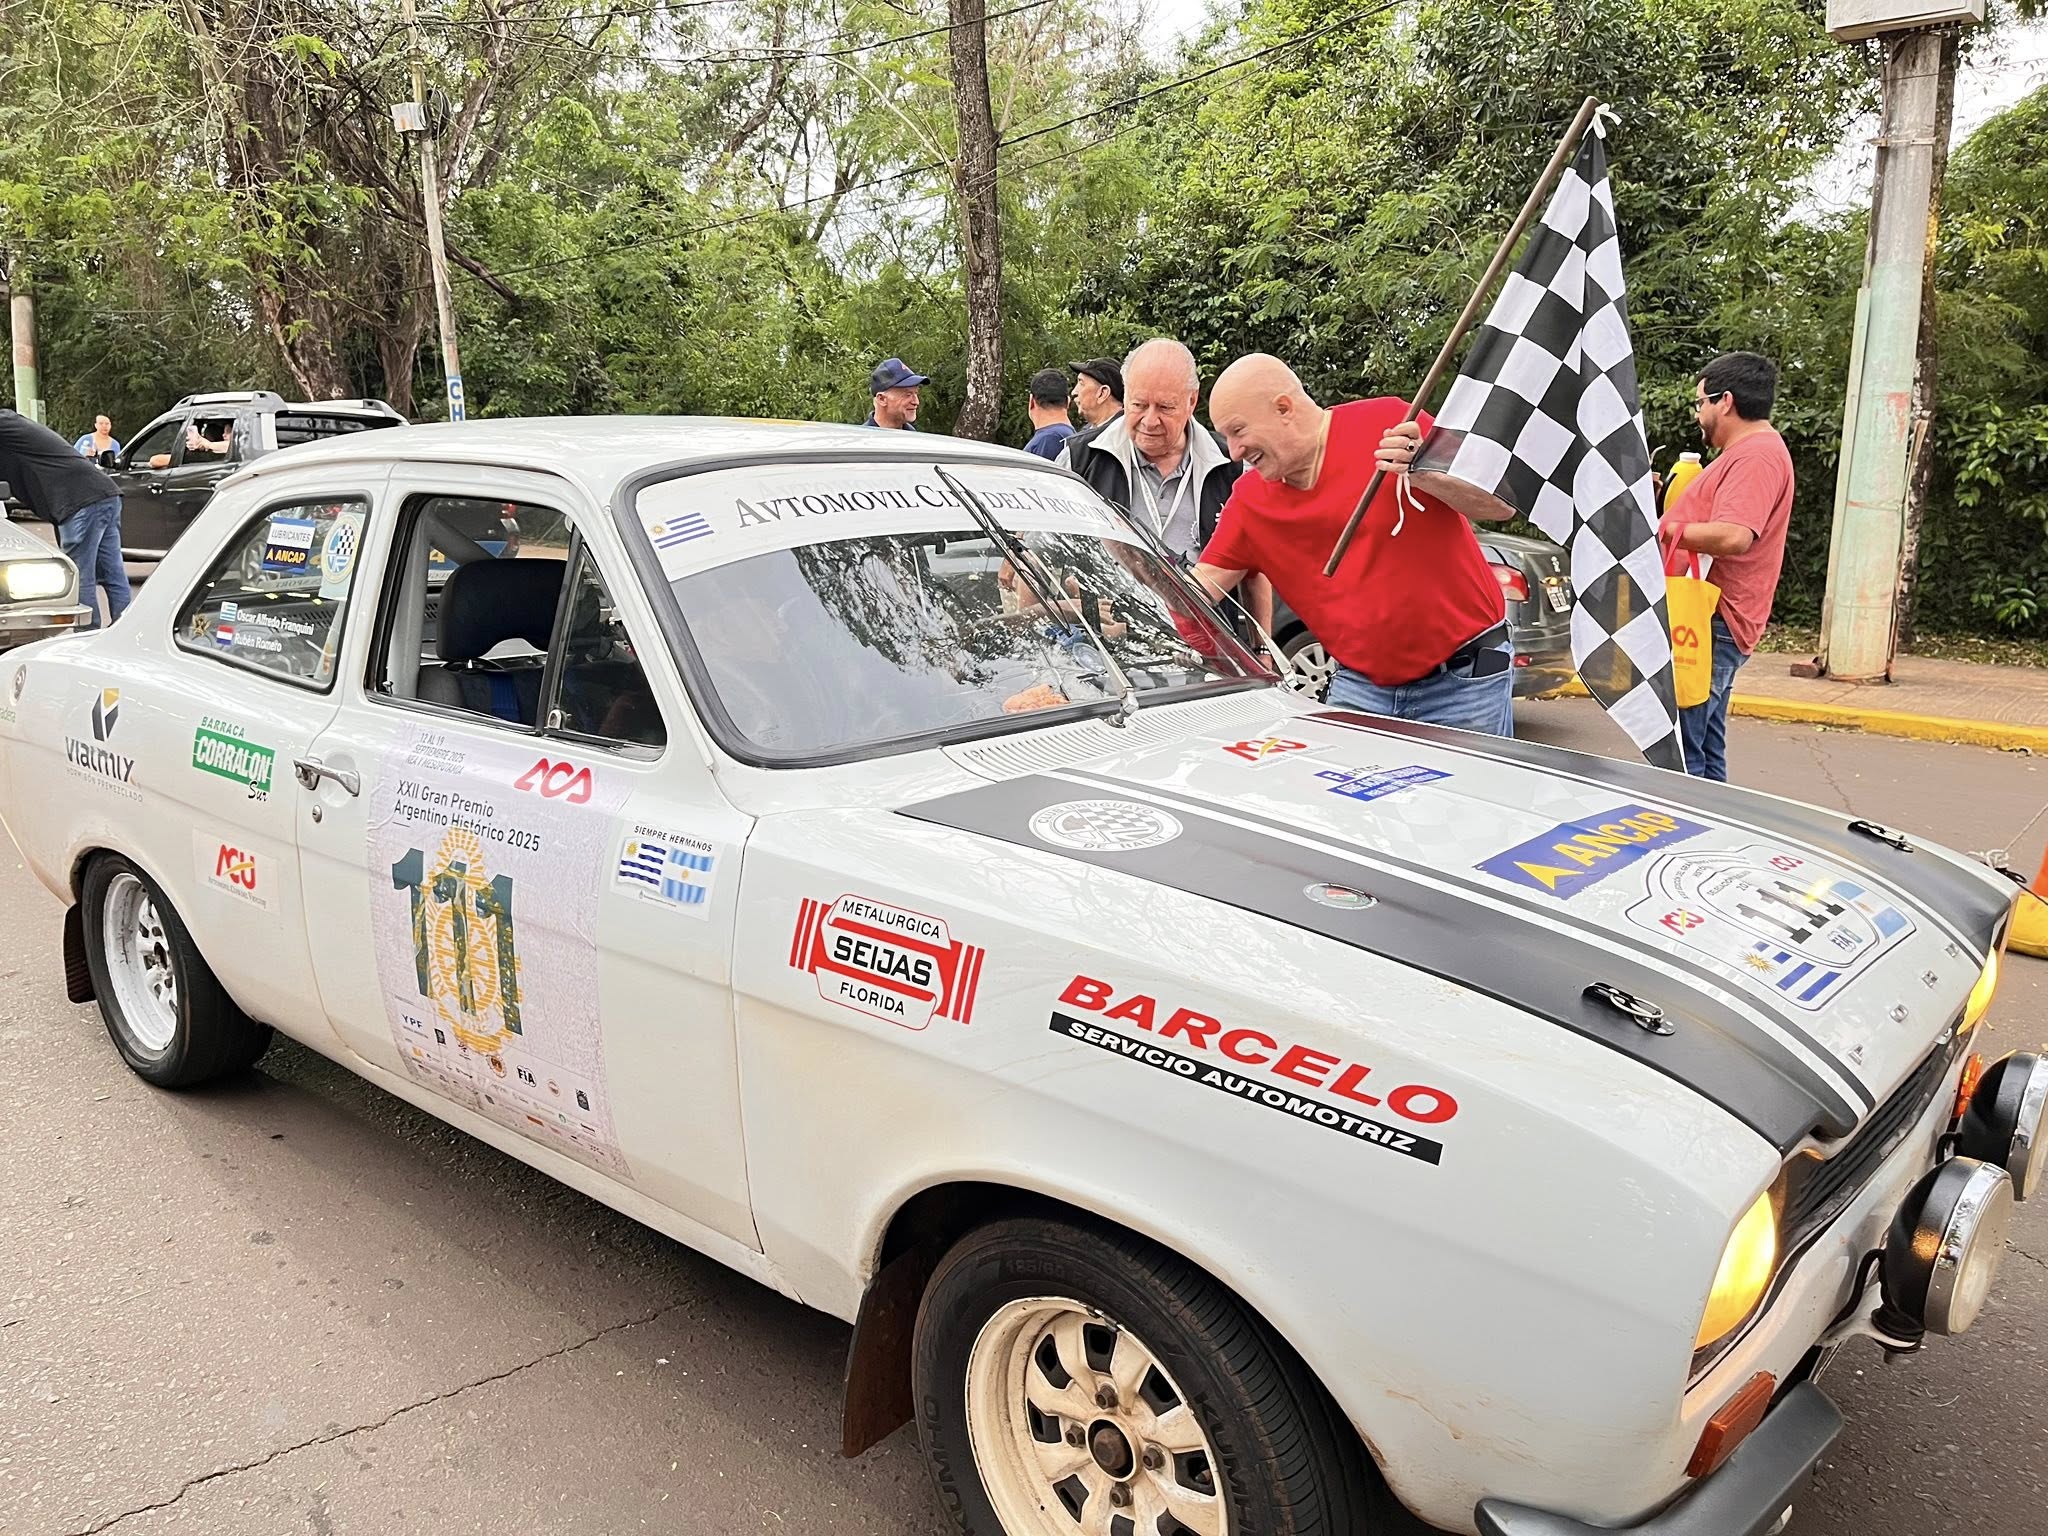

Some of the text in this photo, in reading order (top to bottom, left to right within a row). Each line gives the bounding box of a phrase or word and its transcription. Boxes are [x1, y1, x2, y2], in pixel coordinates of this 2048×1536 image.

[914, 484, 979, 511] CL
[271, 528, 312, 542] LUBRICANTES
[275, 549, 306, 564] ANCAP
[237, 610, 315, 636] Oscar Alfredo Franquini
[234, 632, 282, 652] Rubén Romero
[201, 716, 246, 738] BARRACA
[195, 736, 272, 784] CORRALON
[248, 781, 268, 802] Sur
[396, 780, 494, 818] XXII Gran Premio
[394, 799, 541, 851] Argentino Histórico 2025
[634, 825, 713, 852] SIEMPRE HERMANOS
[1552, 812, 1680, 867] ANCAP
[842, 900, 941, 939] METALURGICA
[1736, 881, 1846, 944] 111
[833, 935, 932, 986] SEIJAS
[840, 981, 905, 1016] FLORIDA
[402, 1014, 423, 1029] YPF
[1058, 974, 1459, 1125] BARCELO
[516, 1068, 536, 1086] FIA
[1068, 1022, 1418, 1153] SERVICIO AUTOMOTRIZ
